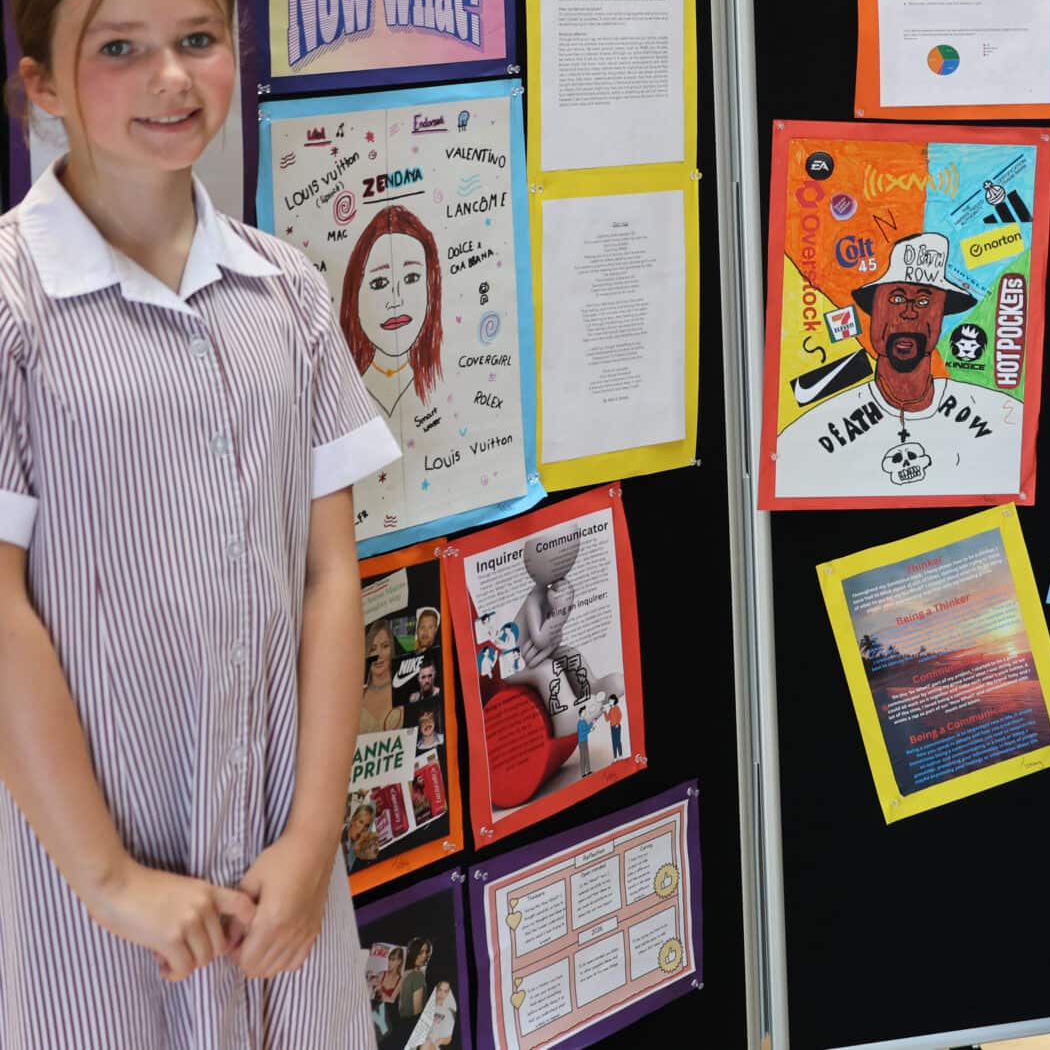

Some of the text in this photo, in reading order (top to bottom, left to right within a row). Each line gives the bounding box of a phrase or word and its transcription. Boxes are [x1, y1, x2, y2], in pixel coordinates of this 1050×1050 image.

[811, 160, 829, 171] EA
[362, 167, 423, 198] ZENDAYA
[284, 179, 319, 211] LOUIS
[446, 192, 507, 218] LANCÔME
[327, 229, 348, 242] MAC
[984, 232, 1023, 252] norton
[834, 235, 875, 269] Colt
[857, 258, 878, 273] 45
[995, 278, 1024, 386] HOT POCKETS
[458, 354, 512, 368] COVERGIRL
[474, 390, 504, 410] ROLEX
[818, 394, 993, 454] DEATH ROW
[424, 451, 461, 472] Louis
[476, 548, 523, 574] Inquirer
[535, 522, 609, 553] Communicator
[906, 557, 943, 573] Thinker
[896, 594, 970, 626] Being a Thinker
[398, 655, 425, 676] NIKE
[910, 729, 939, 744] Being
[939, 727, 946, 735] a
